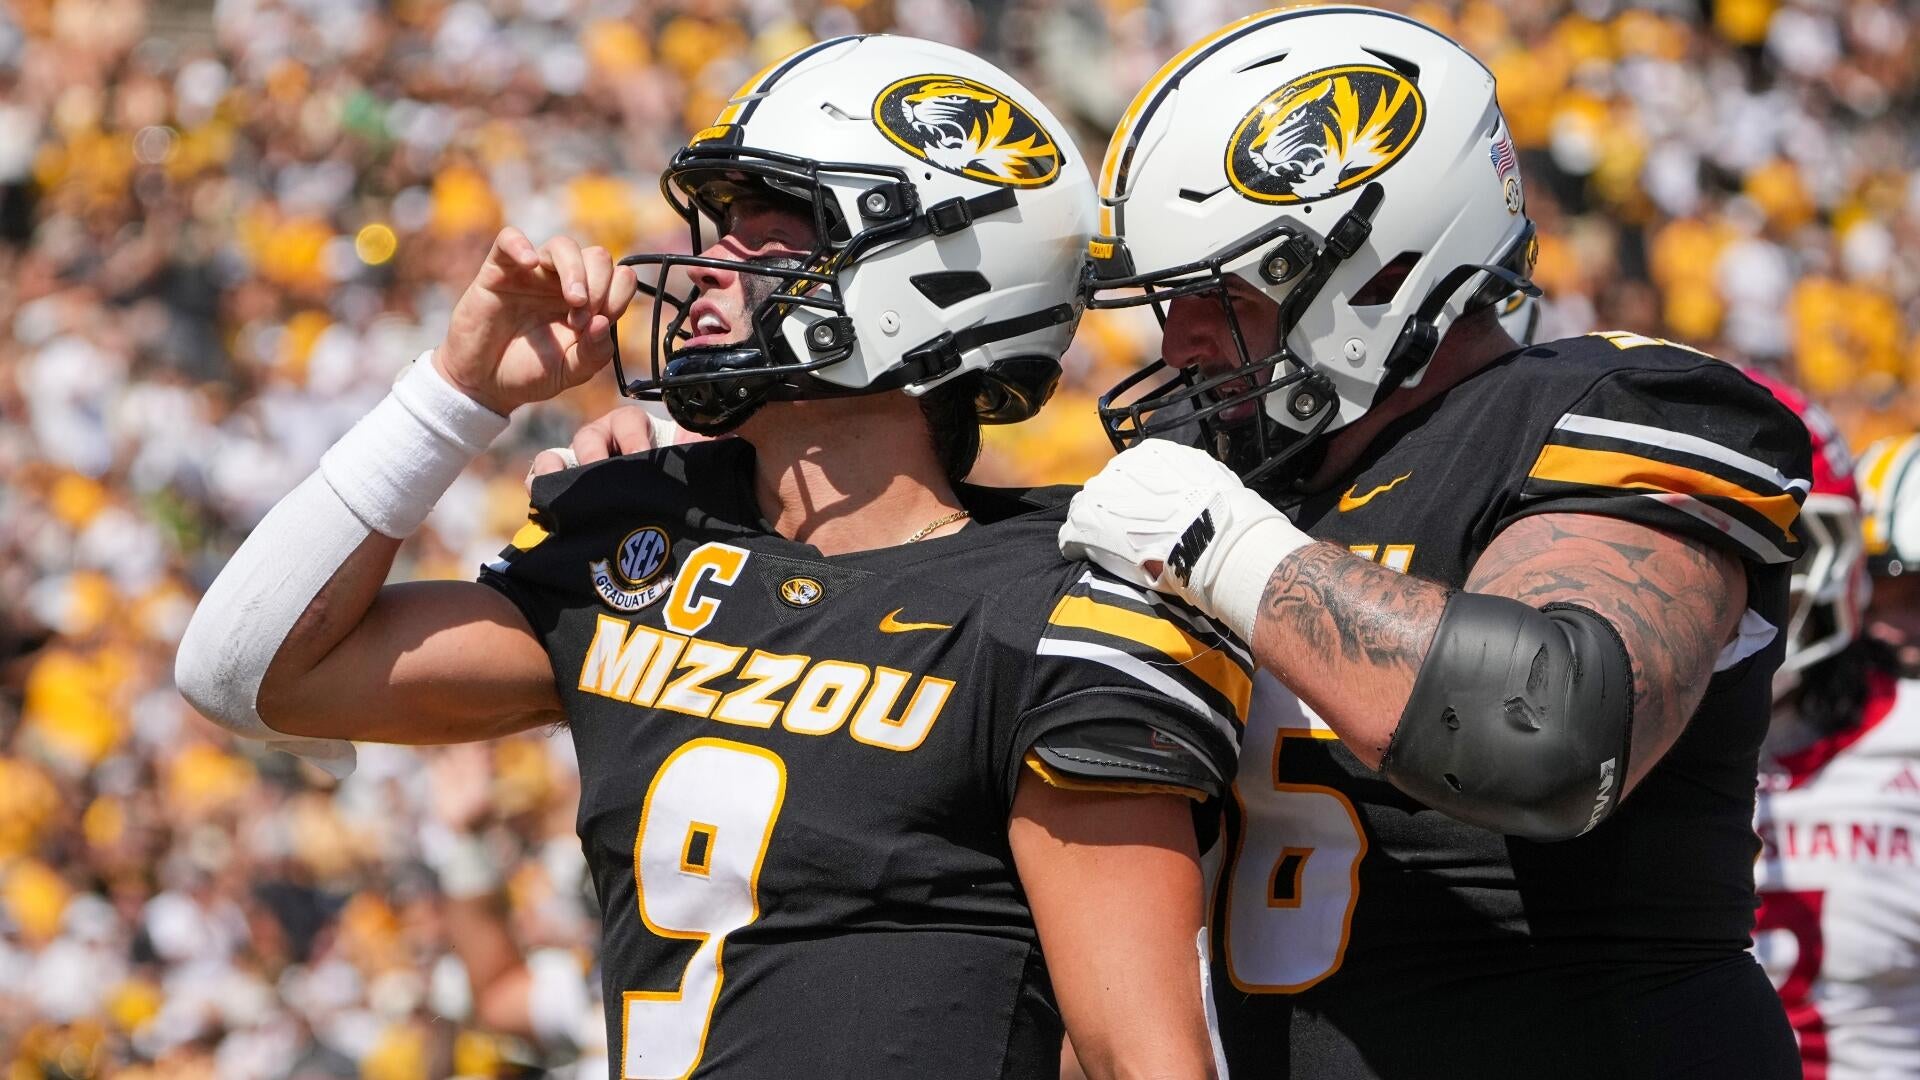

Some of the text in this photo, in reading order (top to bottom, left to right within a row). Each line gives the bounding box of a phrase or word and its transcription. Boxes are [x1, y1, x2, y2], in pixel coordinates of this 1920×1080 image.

[595, 575, 656, 608] GRADUATE
[620, 530, 665, 580] SEC
[662, 541, 751, 636] C
[577, 614, 957, 752] MIZZOU
[1205, 668, 1369, 994] 6
[620, 737, 787, 1080] 9
